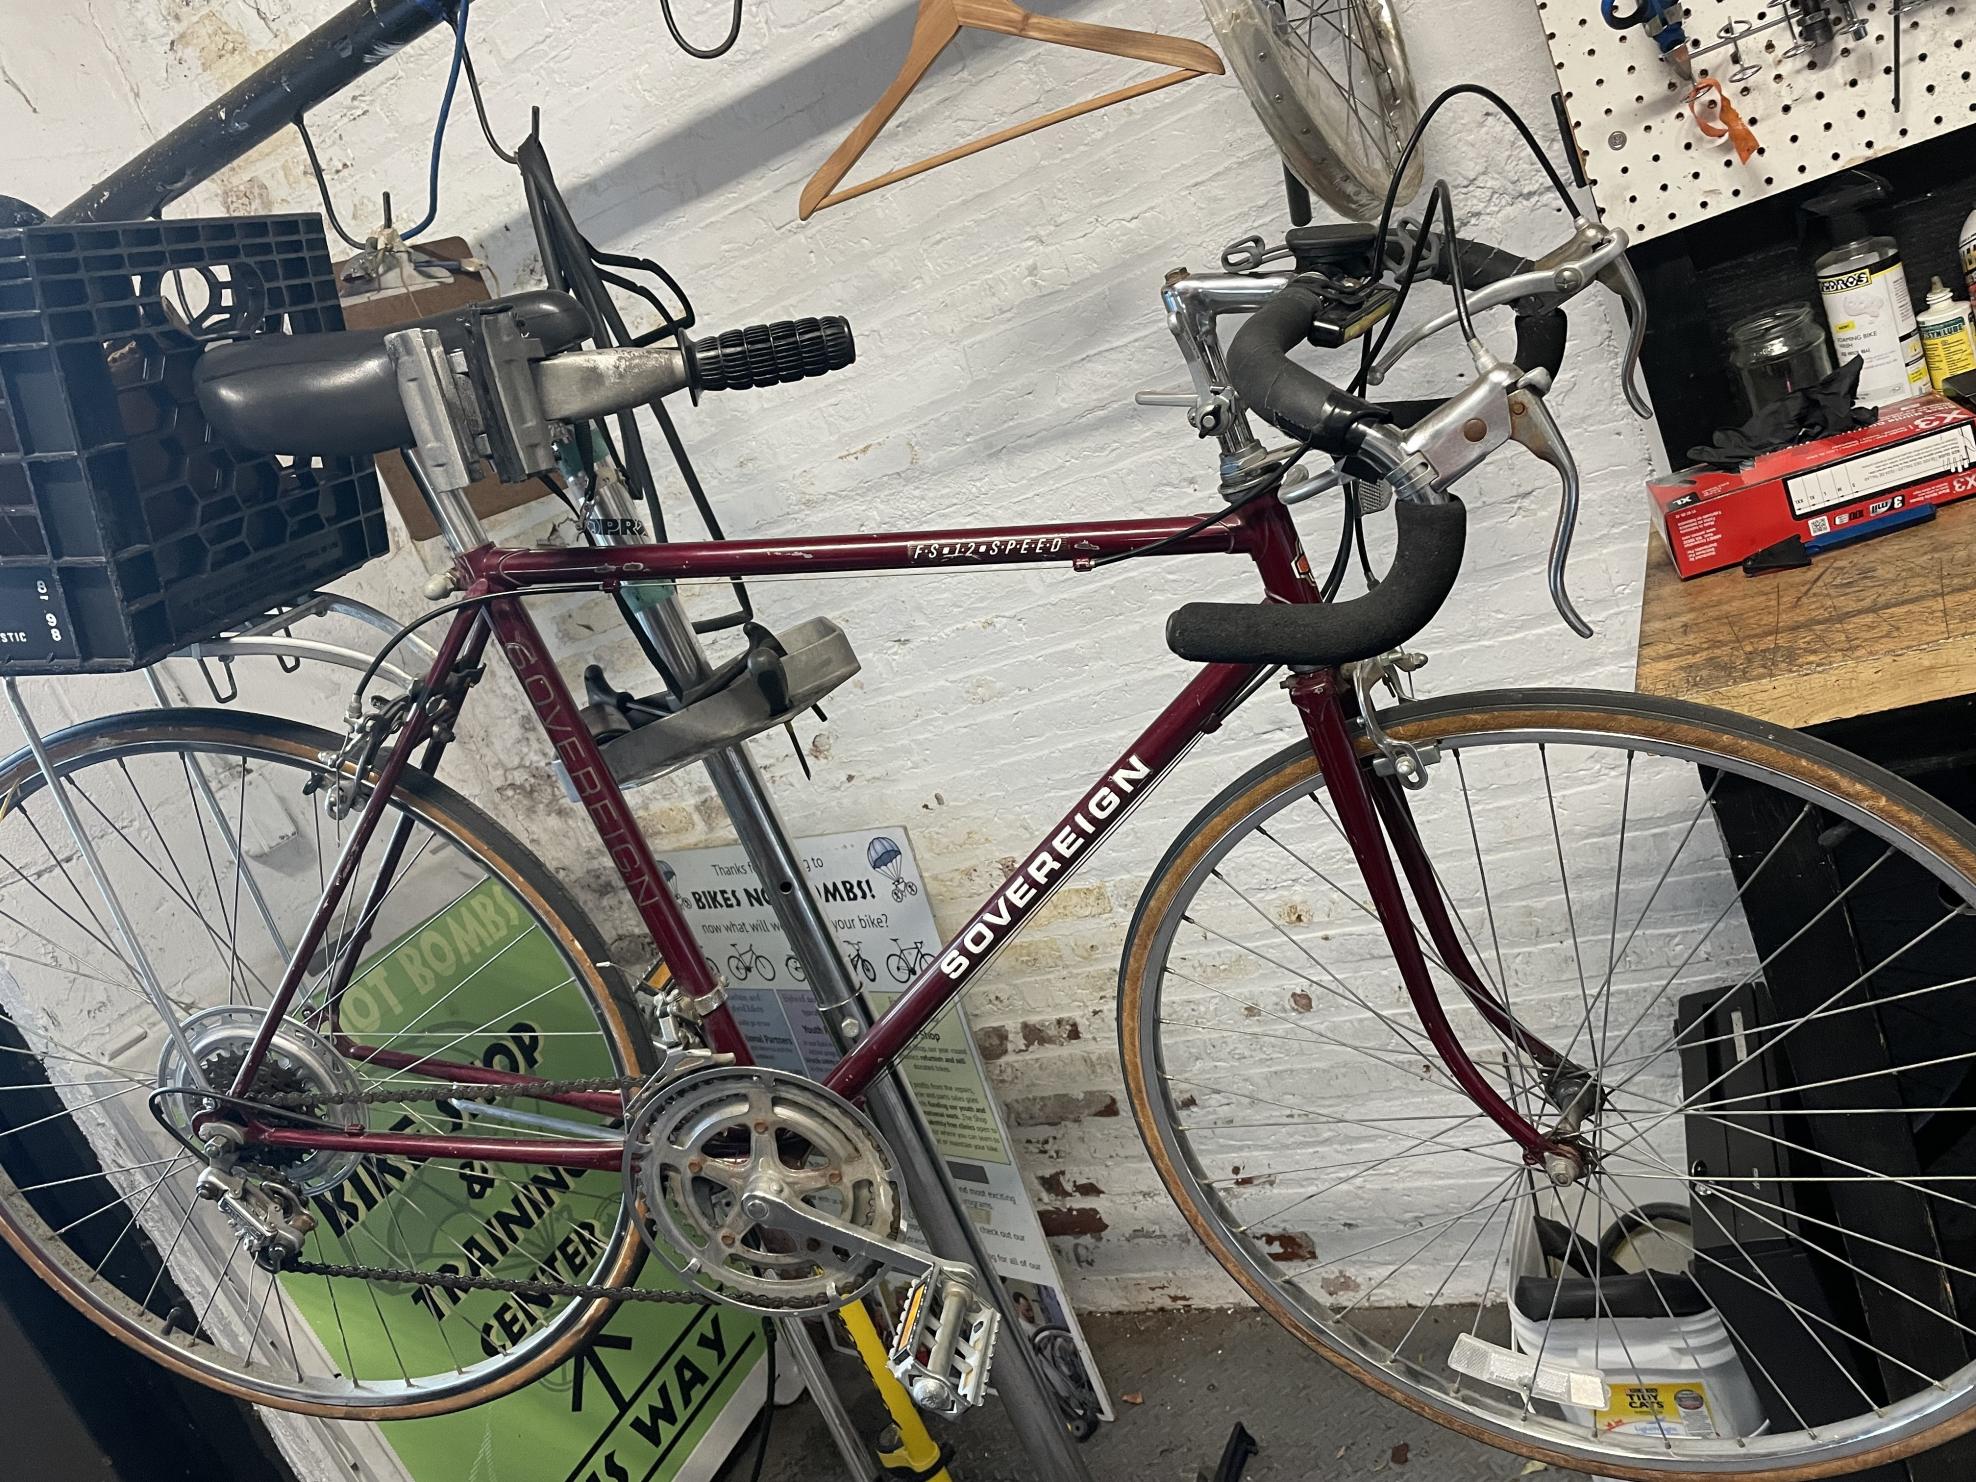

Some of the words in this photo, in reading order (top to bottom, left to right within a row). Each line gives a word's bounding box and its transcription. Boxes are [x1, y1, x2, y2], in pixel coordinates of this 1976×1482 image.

[504, 641, 659, 907] SOVEREIGN
[691, 888, 742, 910] BIKES
[815, 879, 876, 903] MBS!
[712, 863, 748, 877] Thanks
[940, 754, 1152, 980] SOVEREIGN
[338, 964, 404, 1044] OT
[396, 886, 519, 995] BOMBS
[702, 922, 723, 935] now
[723, 920, 750, 935] what
[749, 919, 770, 933] will
[831, 918, 857, 933] your
[858, 914, 889, 929] bike?
[459, 1161, 498, 1200] &
[629, 1313, 727, 1449] WAY
